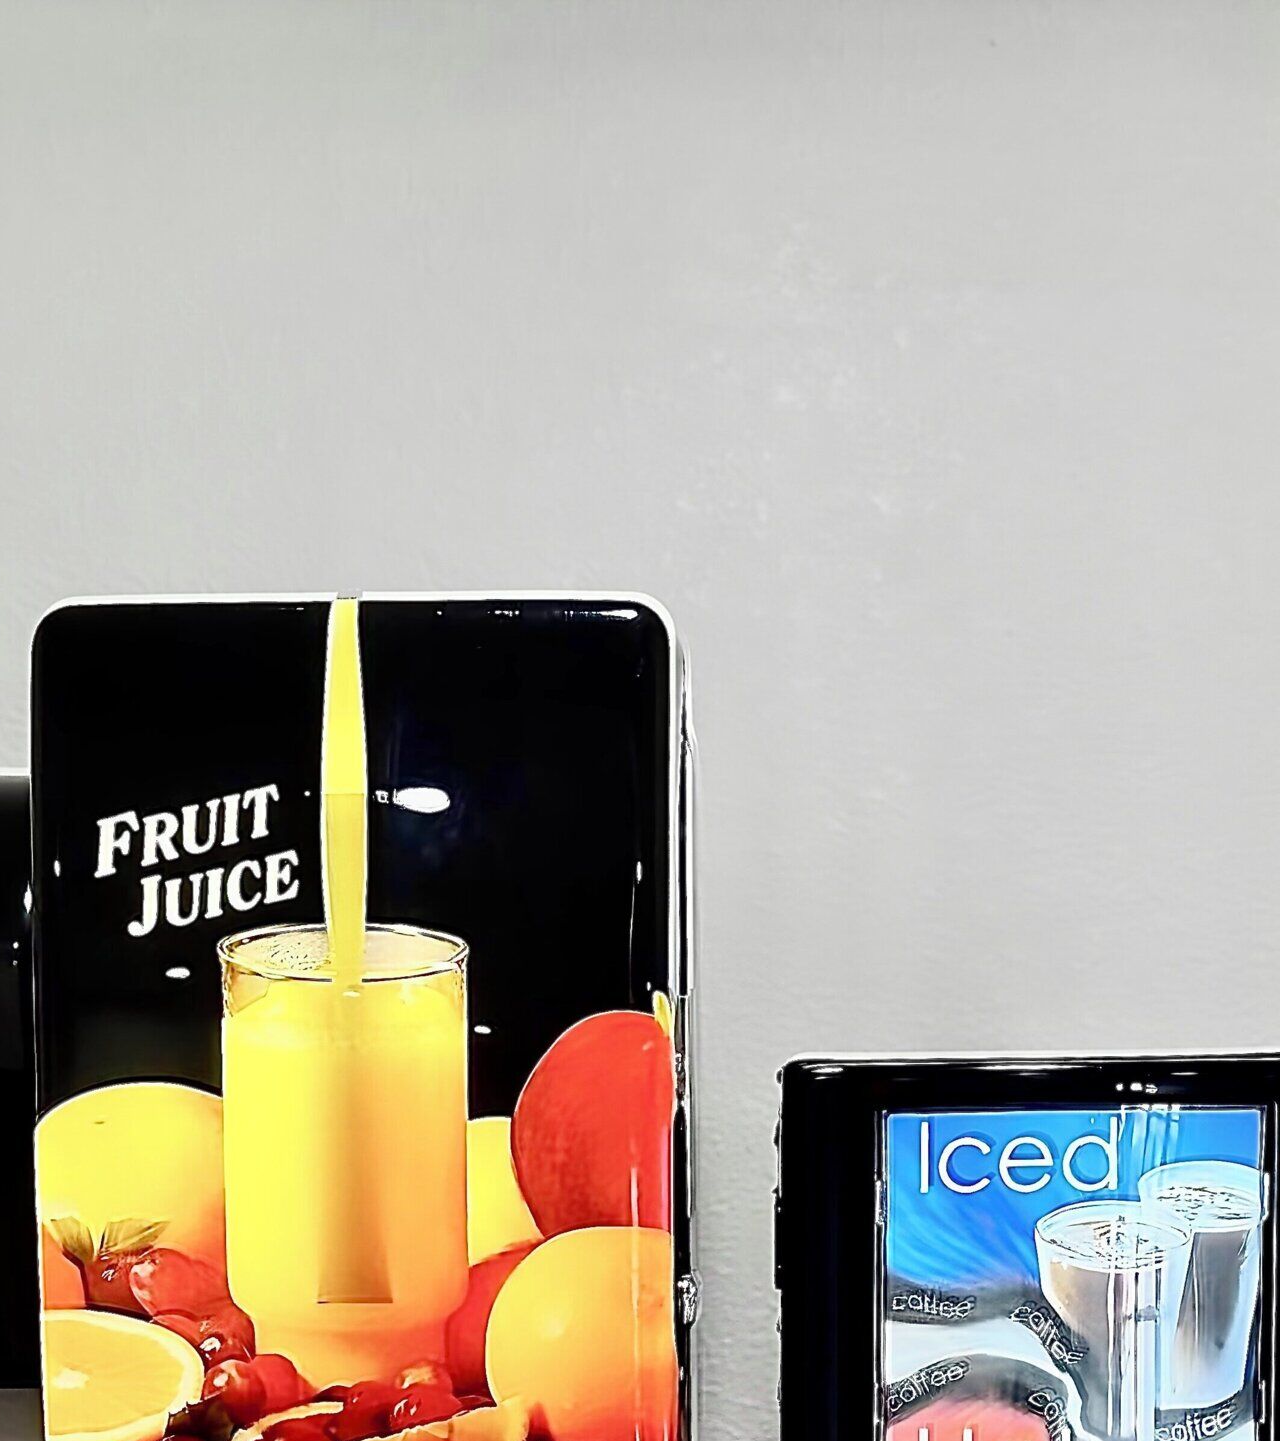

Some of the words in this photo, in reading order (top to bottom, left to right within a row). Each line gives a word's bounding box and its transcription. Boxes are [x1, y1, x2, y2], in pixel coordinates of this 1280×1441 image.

[93, 783, 280, 879] FRUIT
[126, 849, 300, 938] JUICE
[920, 1115, 1119, 1195] Iced
